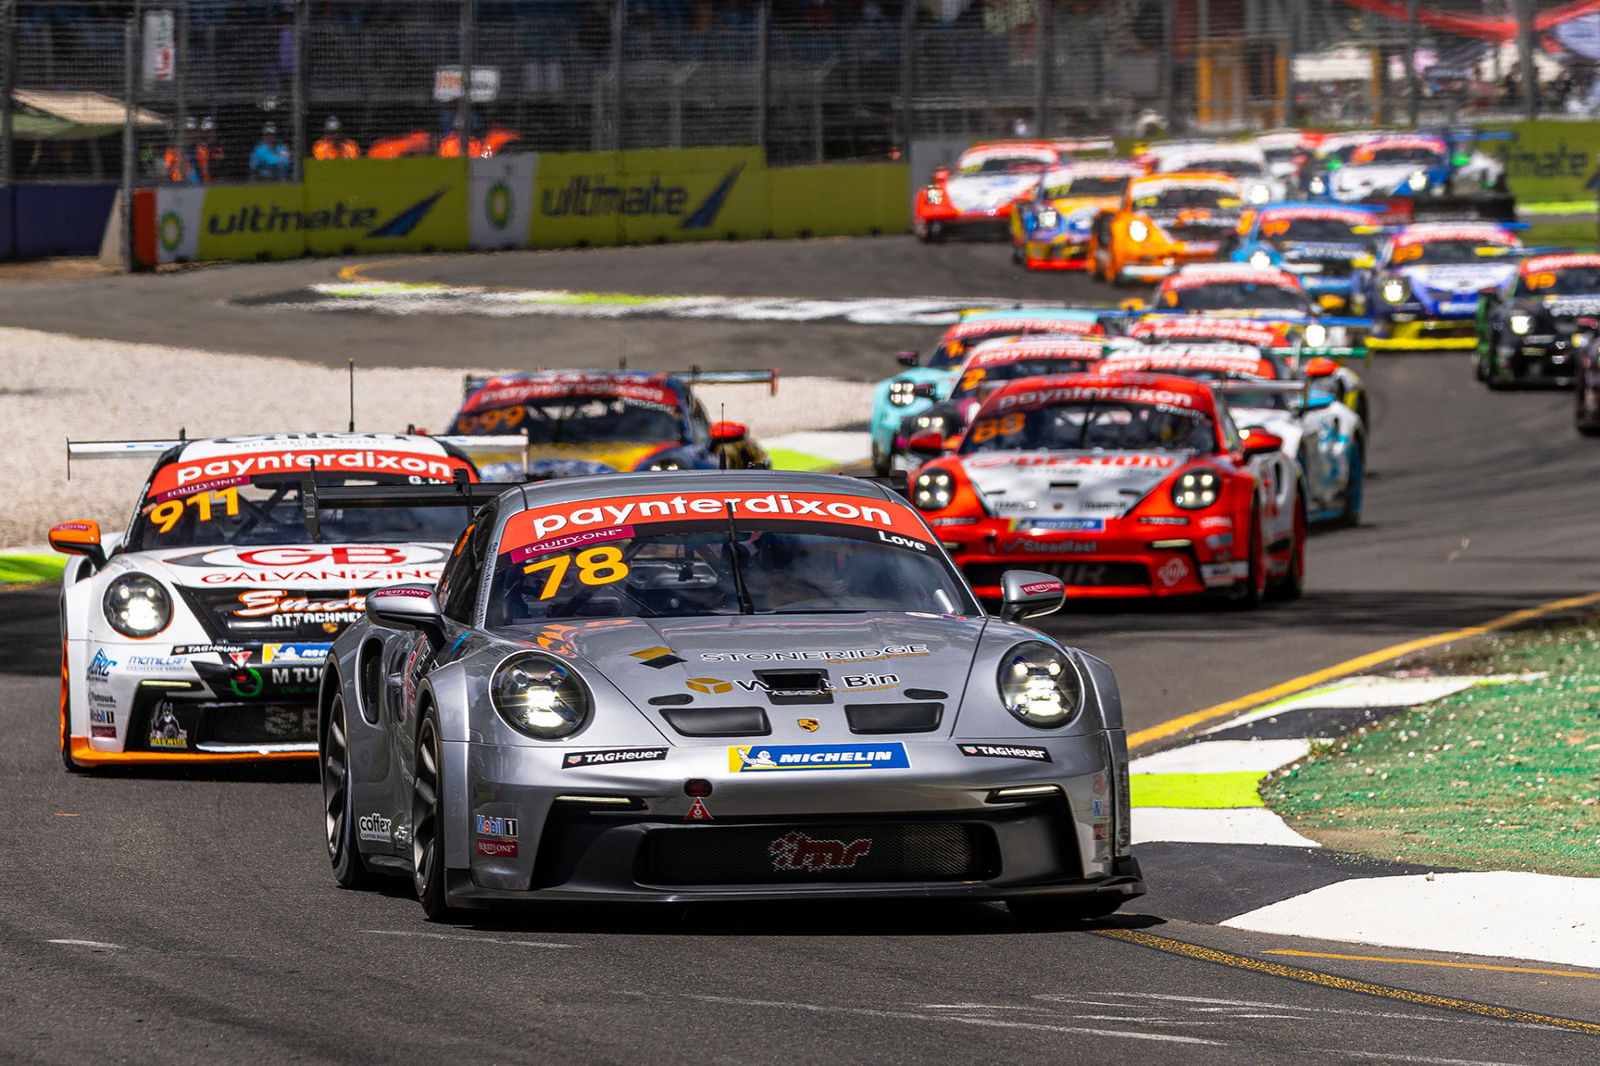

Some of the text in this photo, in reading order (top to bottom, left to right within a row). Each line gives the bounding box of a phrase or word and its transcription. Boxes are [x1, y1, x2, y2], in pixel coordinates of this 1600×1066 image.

[542, 174, 689, 217] ultimate
[208, 202, 377, 235] ultimate
[999, 386, 1192, 408] paynterdixon
[177, 451, 451, 487] paynterdixon
[150, 486, 240, 534] 911
[533, 494, 893, 540] paynterdixon
[878, 530, 928, 551] Love
[238, 547, 408, 567] GB
[522, 546, 630, 601] 78
[700, 644, 930, 663] STONERIDGE
[272, 668, 289, 684] M
[841, 673, 900, 689] Bin
[779, 751, 892, 763] MICHELIN
[359, 814, 392, 834] coffex
[476, 814, 503, 836] Mobil
